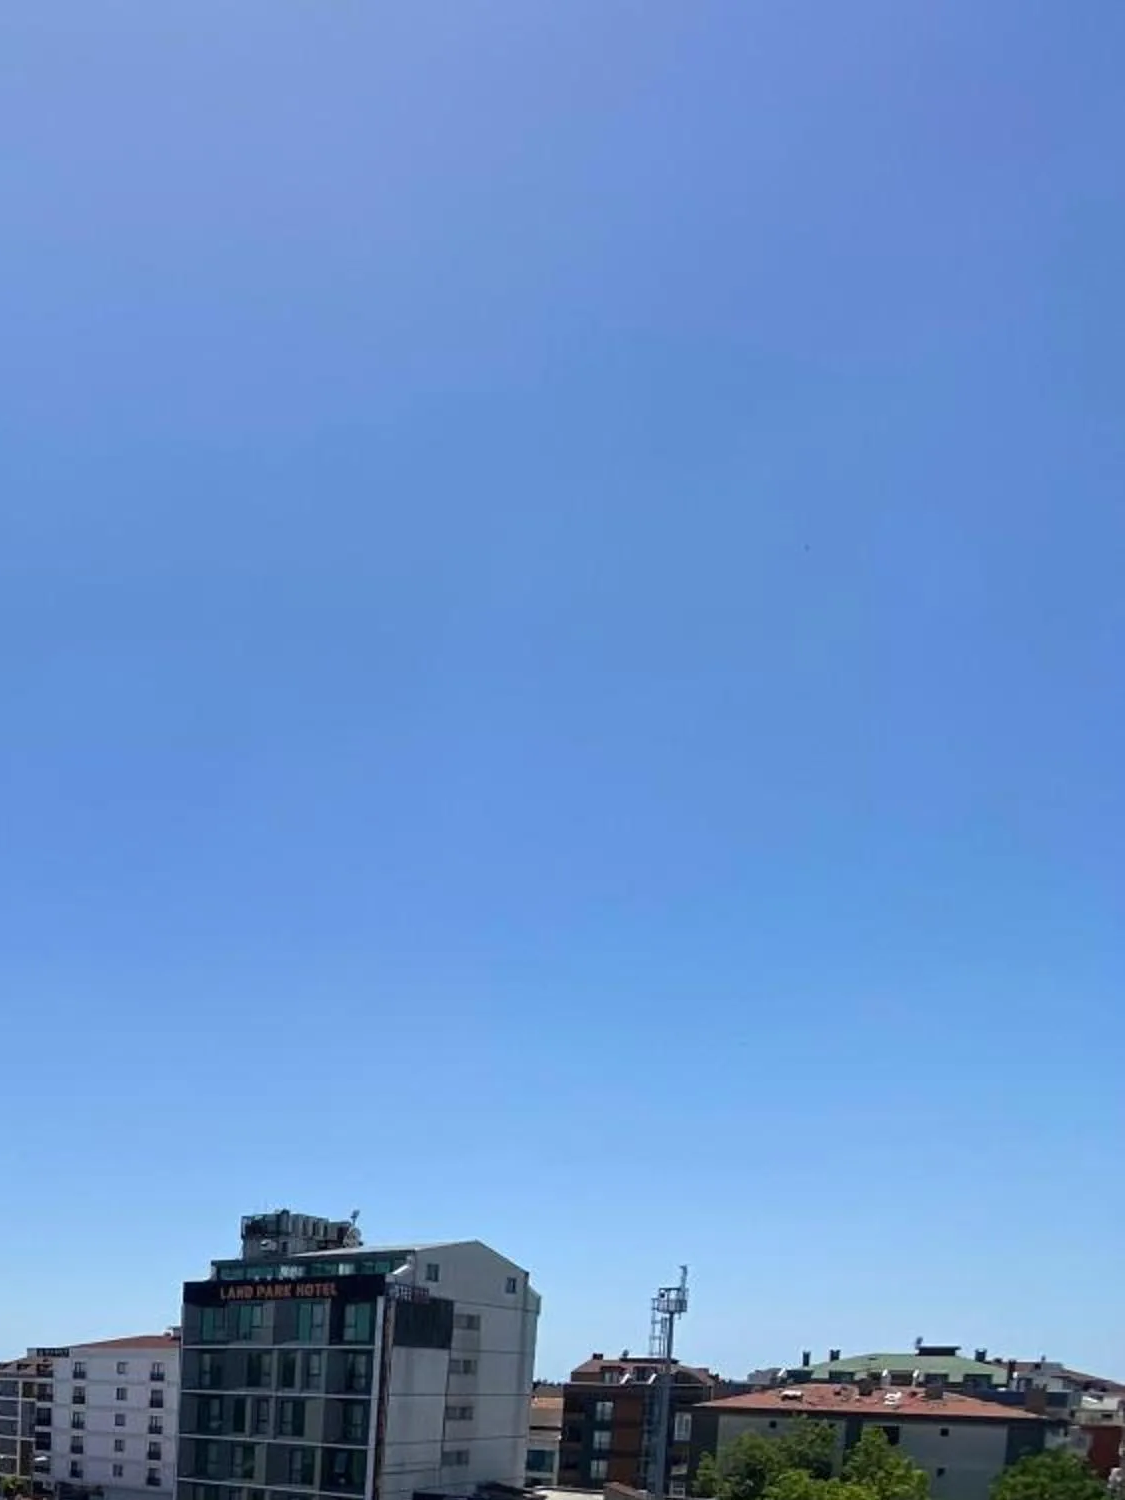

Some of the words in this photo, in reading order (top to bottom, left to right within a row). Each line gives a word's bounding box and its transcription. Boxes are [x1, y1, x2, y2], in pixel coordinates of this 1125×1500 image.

[220, 1286, 254, 1299] LAND
[256, 1284, 293, 1298] PARK
[296, 1283, 338, 1297] HOTEL
